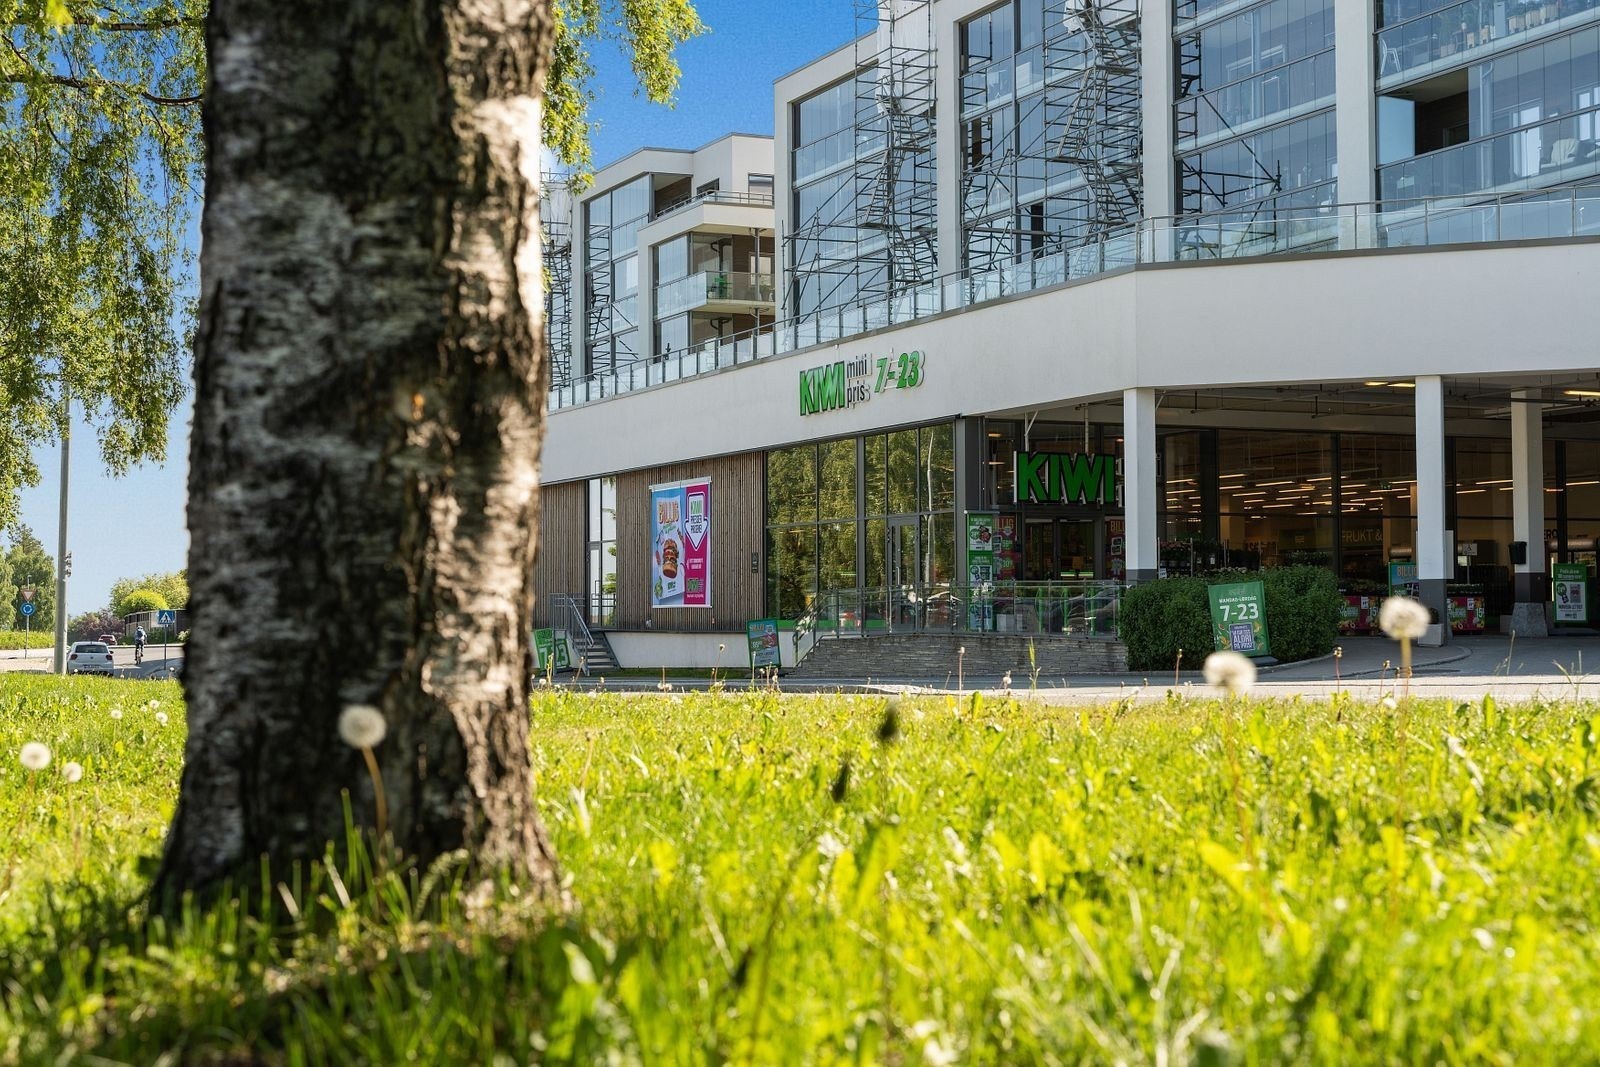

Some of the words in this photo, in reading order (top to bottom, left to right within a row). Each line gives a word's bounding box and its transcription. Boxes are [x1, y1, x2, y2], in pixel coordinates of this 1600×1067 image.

[846, 353, 868, 379] mini
[874, 350, 920, 393] 7-23
[800, 361, 845, 416] KIWI
[846, 380, 866, 409] pris
[1017, 451, 1116, 503] KIWI
[1219, 603, 1259, 621] 7-23
